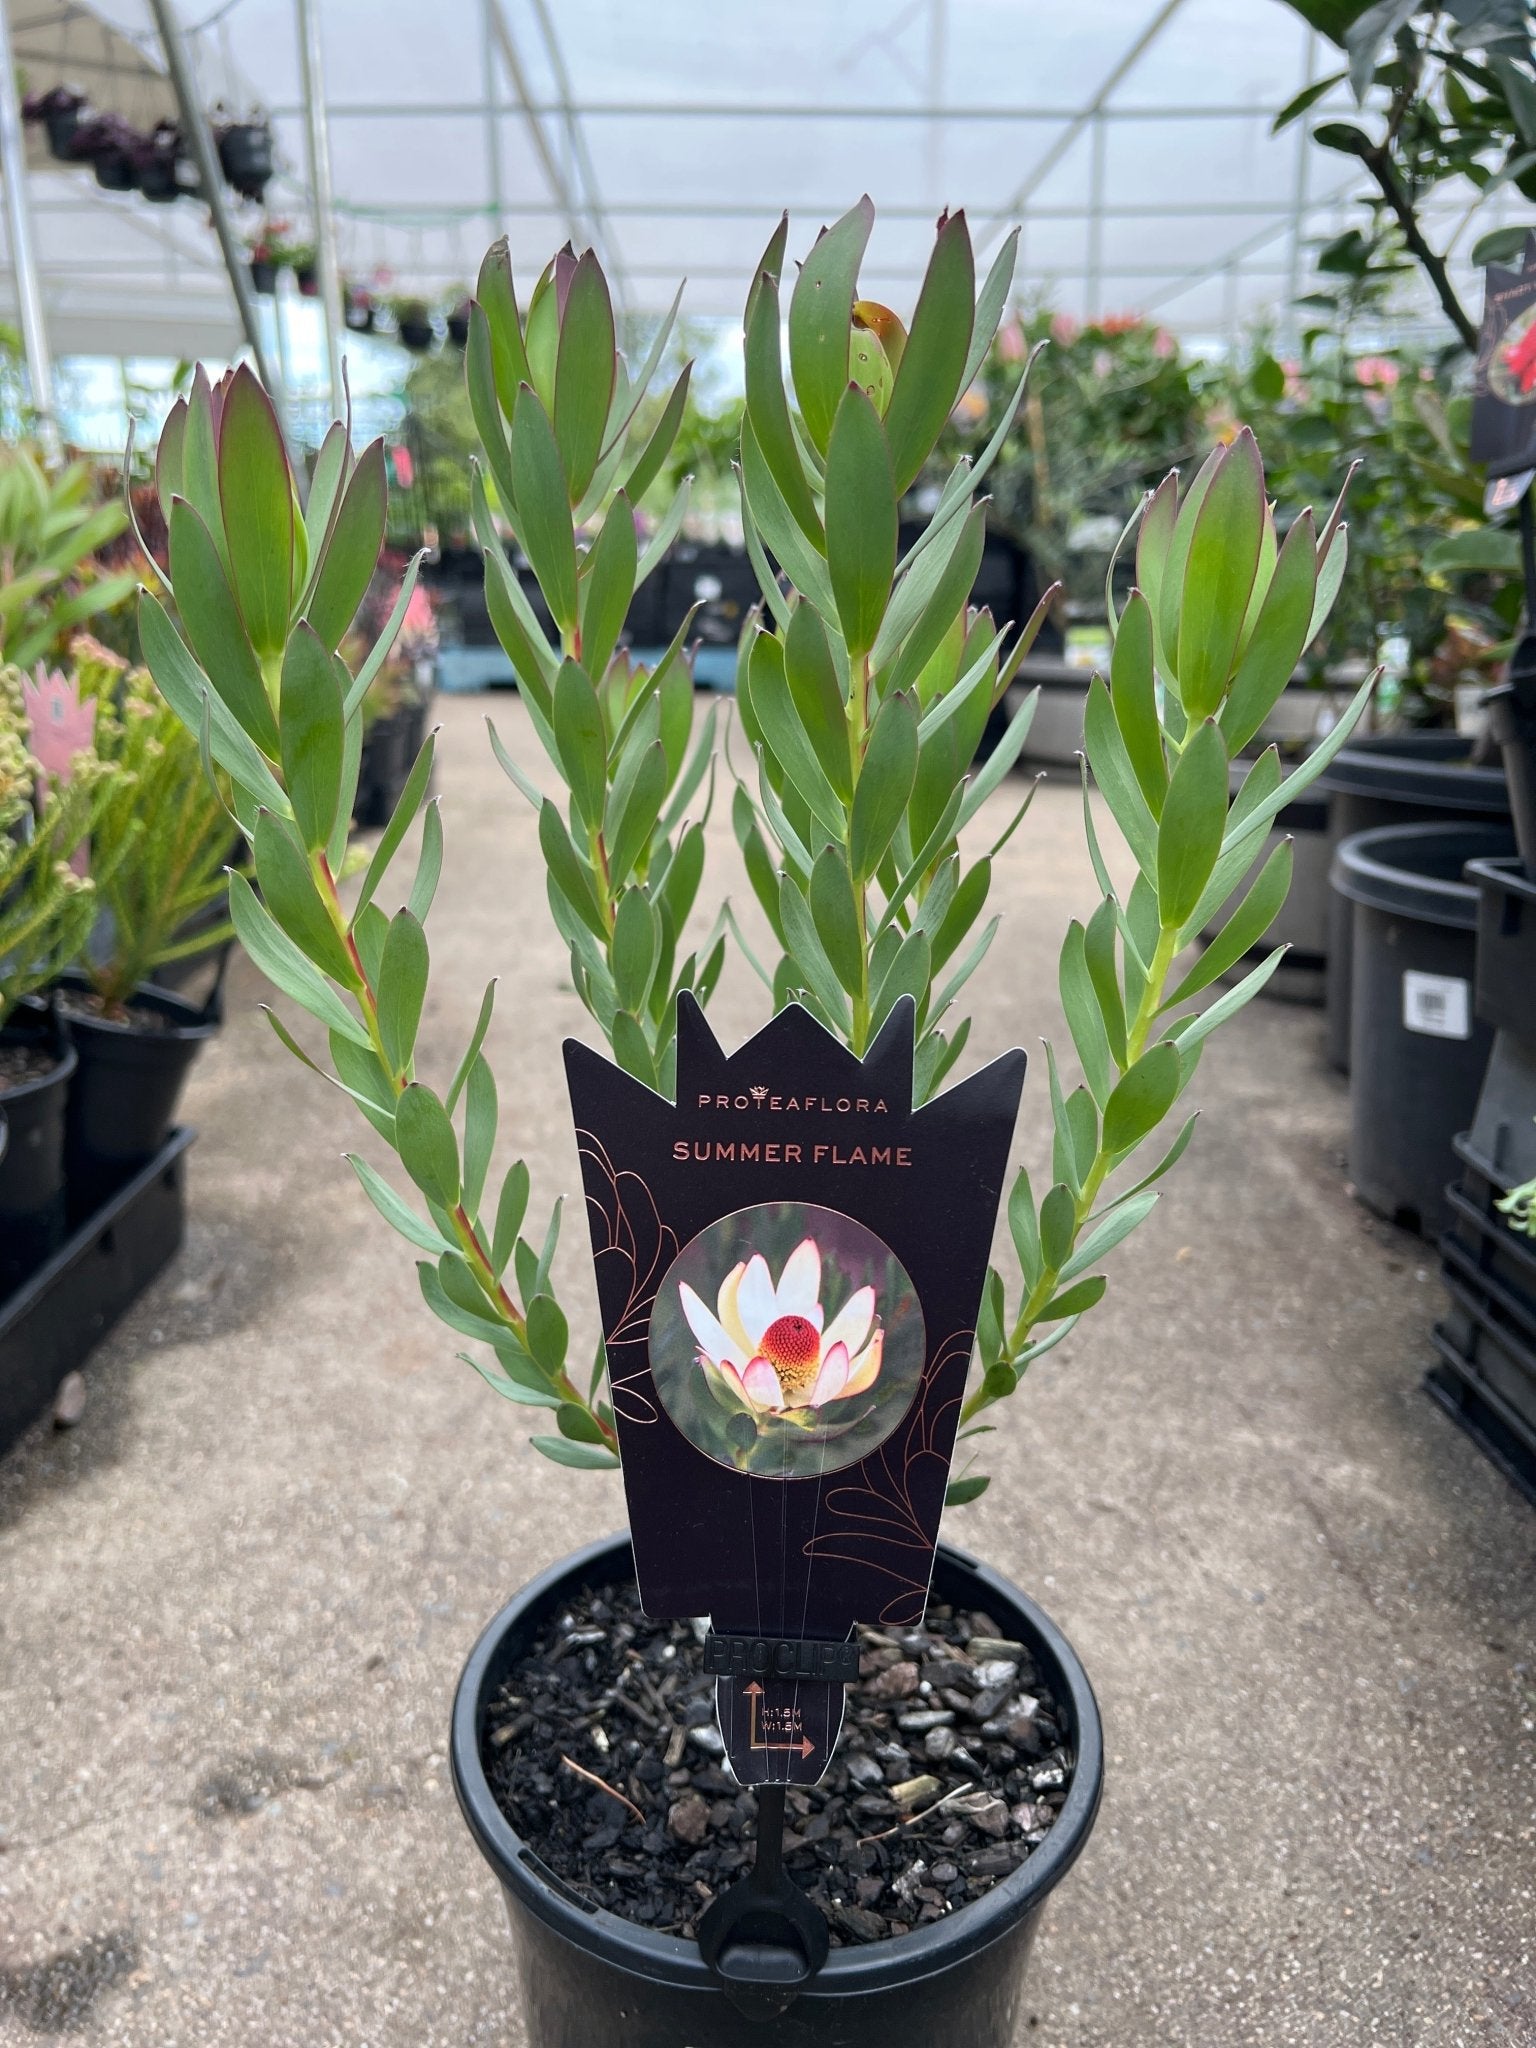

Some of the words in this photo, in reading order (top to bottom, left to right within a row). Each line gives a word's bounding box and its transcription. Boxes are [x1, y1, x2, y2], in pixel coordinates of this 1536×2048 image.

[698, 1094, 888, 1113] PROTEAFLORA
[672, 1142, 802, 1164] SUMMER
[813, 1145, 913, 1166] FLAME
